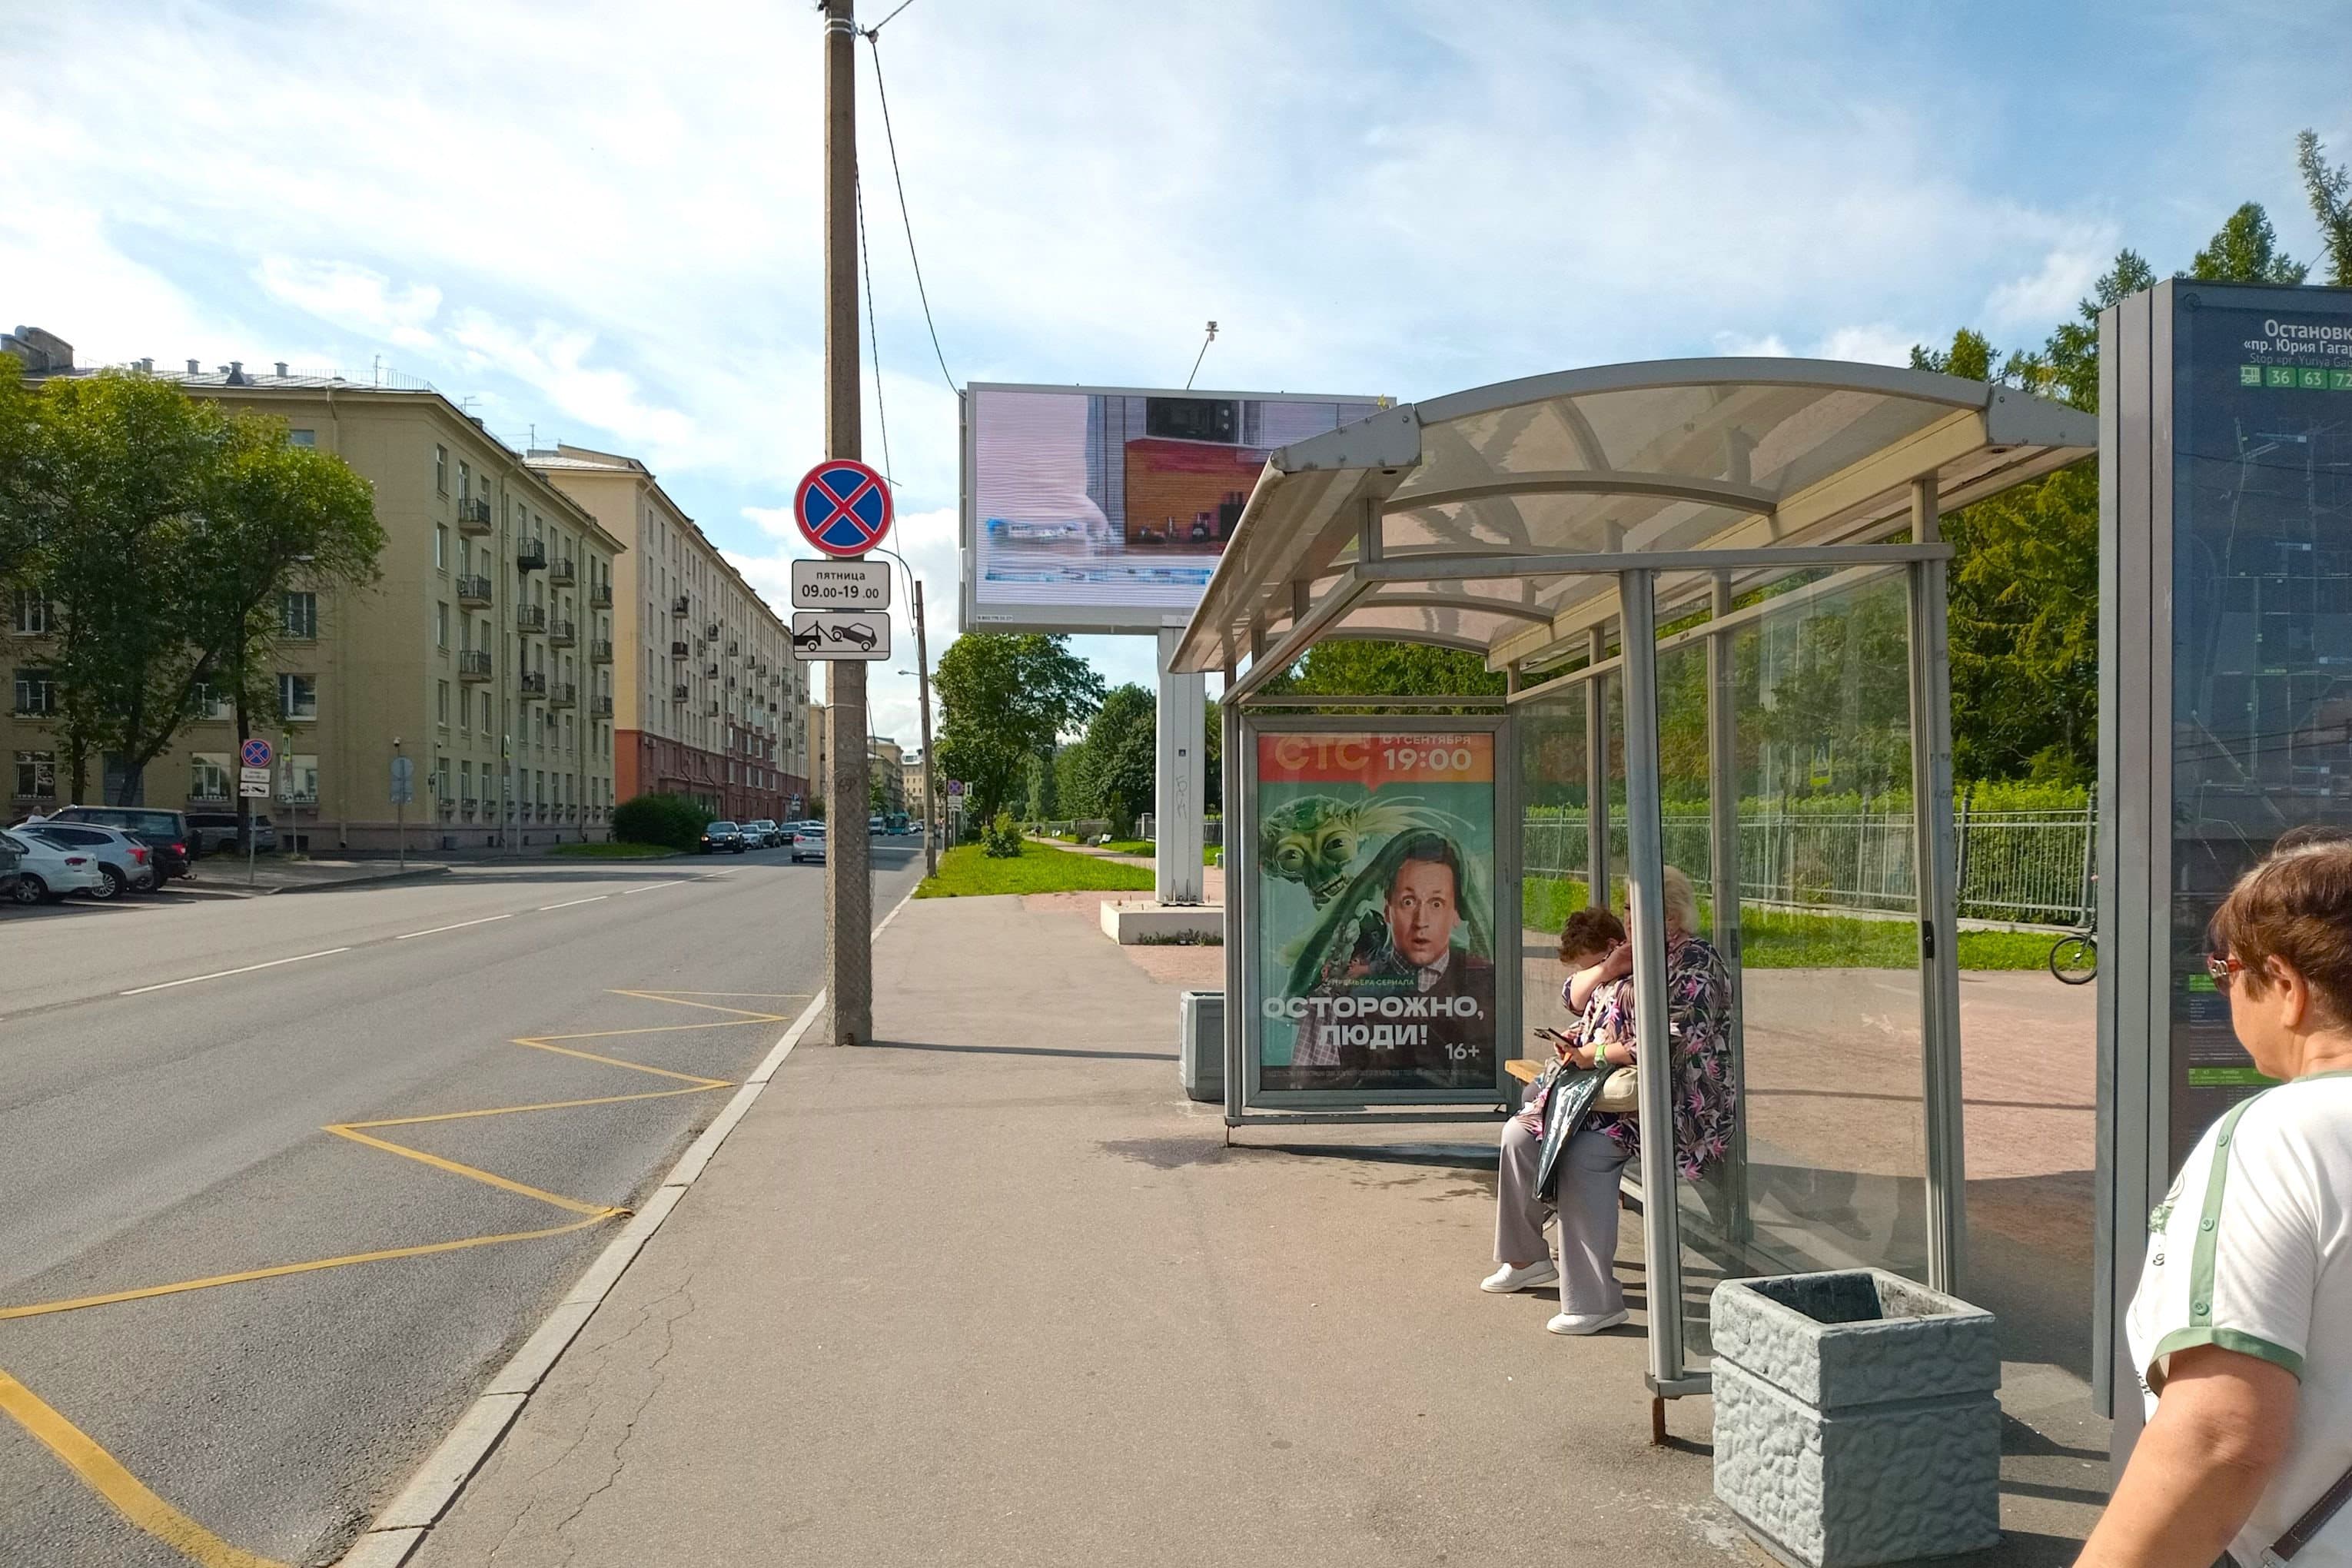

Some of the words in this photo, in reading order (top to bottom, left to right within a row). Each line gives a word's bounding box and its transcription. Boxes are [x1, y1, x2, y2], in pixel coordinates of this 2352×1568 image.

[2244, 340, 2272, 354] «пр.
[2276, 338, 2315, 355] Юрия
[2250, 353, 2273, 364] Stop
[2298, 355, 2330, 368] Yuriya
[2272, 370, 2290, 384] 36
[2305, 372, 2321, 385] 63
[2336, 374, 2352, 387] 72
[816, 572, 866, 581] пятница
[1404, 735, 1471, 745] СЕНТЯБРЯ
[1274, 735, 1370, 770] СТС
[1384, 748, 1472, 771] 19:00
[1262, 996, 1484, 1021] ОСТОРОЖНО,
[1318, 1024, 1428, 1050] ЛЮДИ!
[1445, 1042, 1480, 1060] 16+
